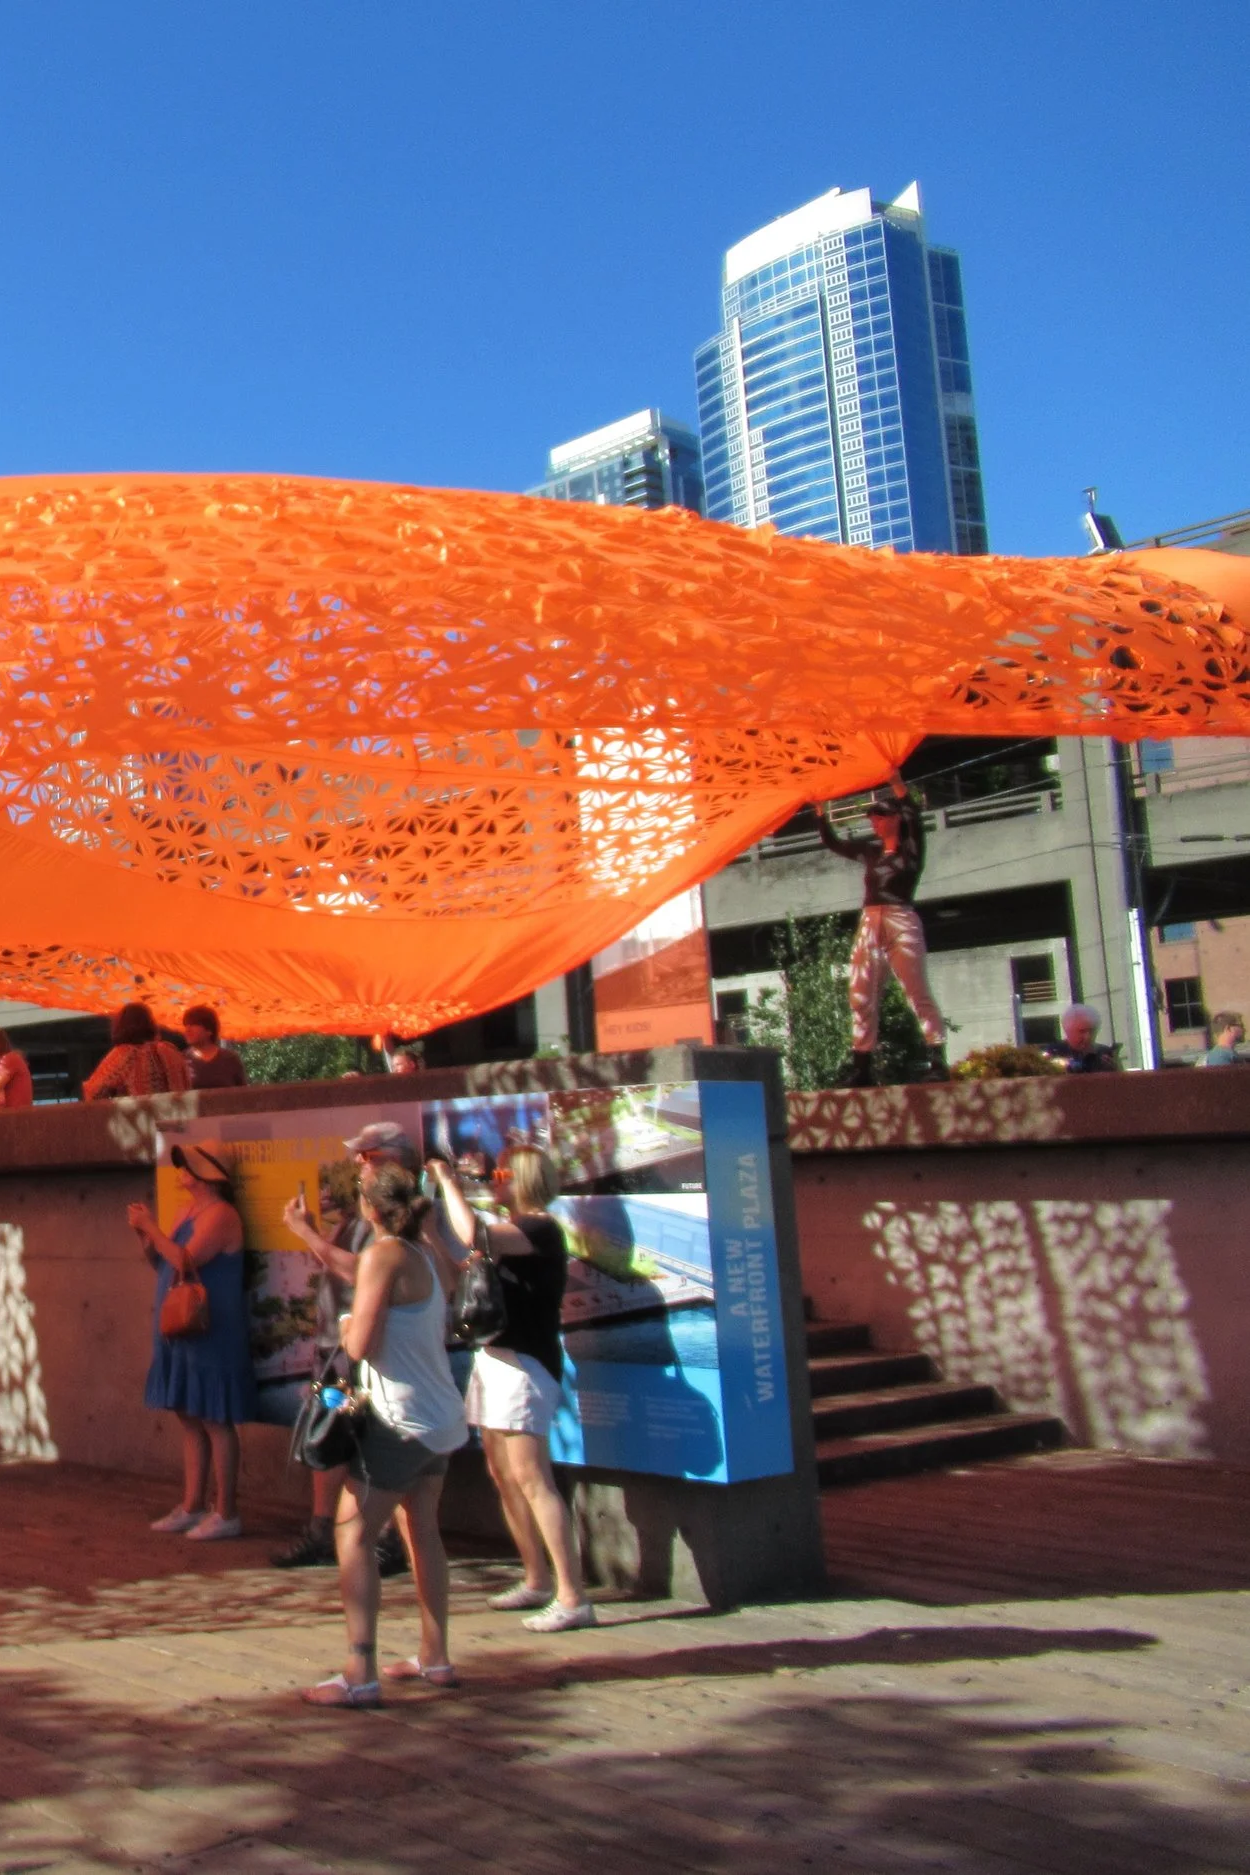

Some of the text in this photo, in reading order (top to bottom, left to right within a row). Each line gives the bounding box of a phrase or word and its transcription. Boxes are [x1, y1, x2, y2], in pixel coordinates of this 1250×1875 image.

[725, 1239, 749, 1317] A NEW
[737, 1153, 775, 1403] WATERFRONT PLAZA
